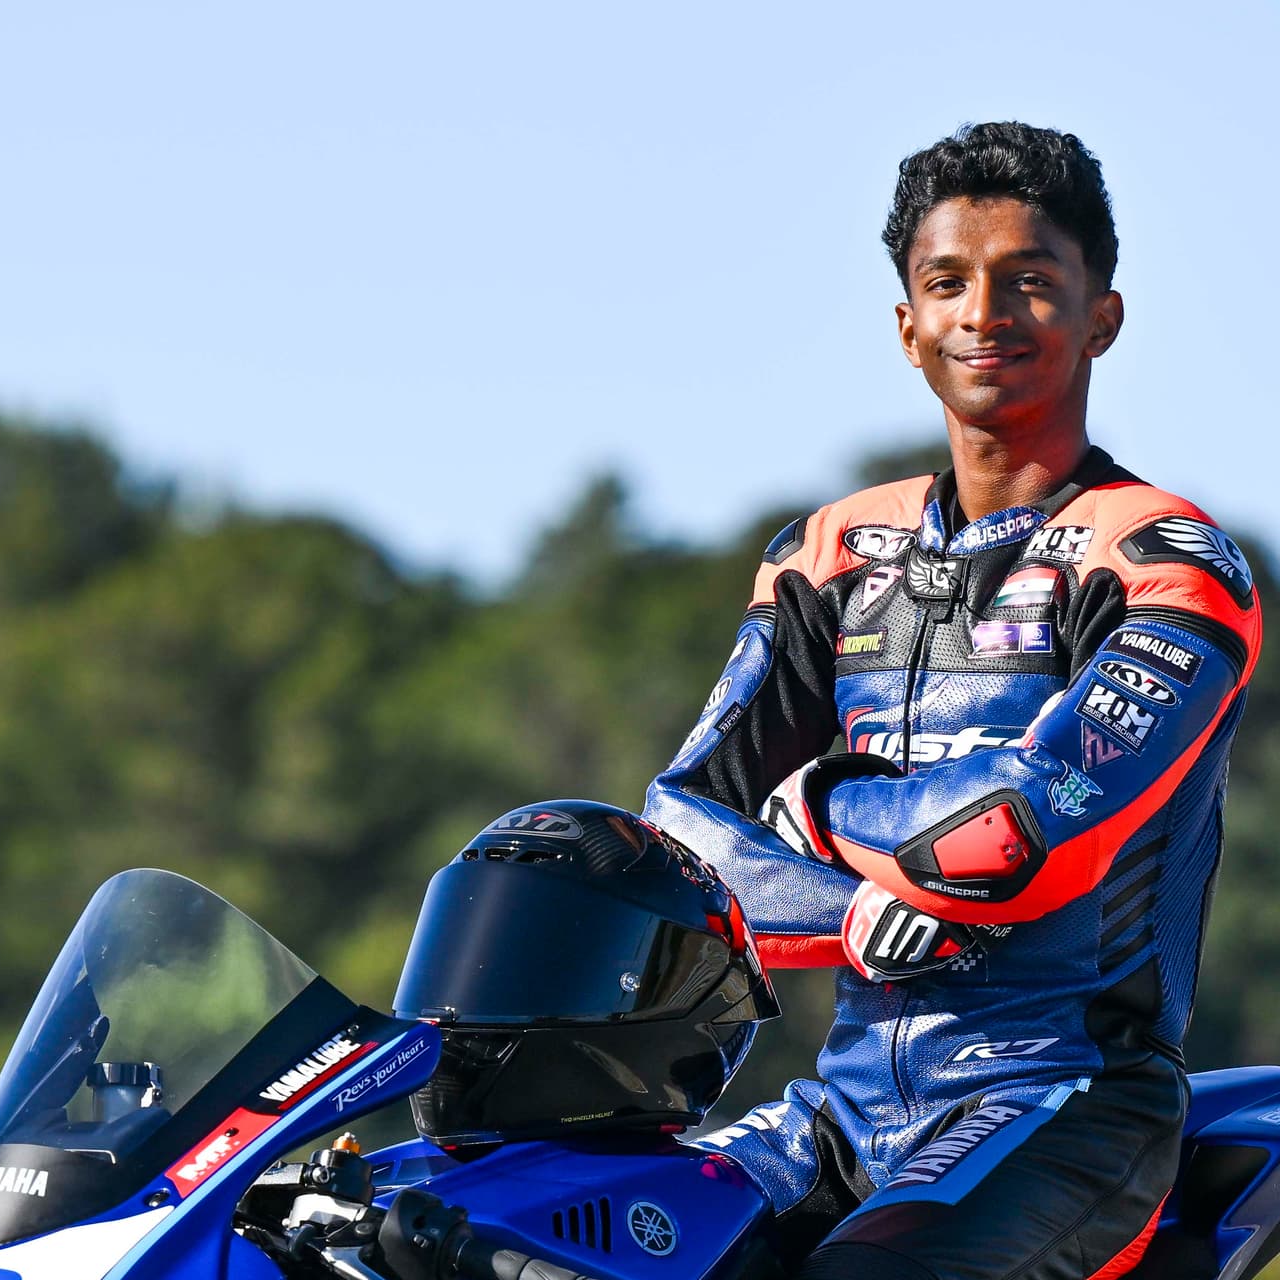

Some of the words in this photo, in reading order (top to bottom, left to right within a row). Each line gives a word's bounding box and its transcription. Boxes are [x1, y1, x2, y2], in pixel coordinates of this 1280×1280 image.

[1120, 632, 1194, 671] YAMALUBE
[1082, 704, 1104, 722] HOUSE
[1102, 715, 1113, 726] OF
[1111, 722, 1142, 747] MACHINES
[259, 1033, 361, 1102] YAMALUBE
[331, 1075, 371, 1113] Revs
[397, 1039, 426, 1066] Heart
[888, 1105, 1024, 1186] YAMAHA
